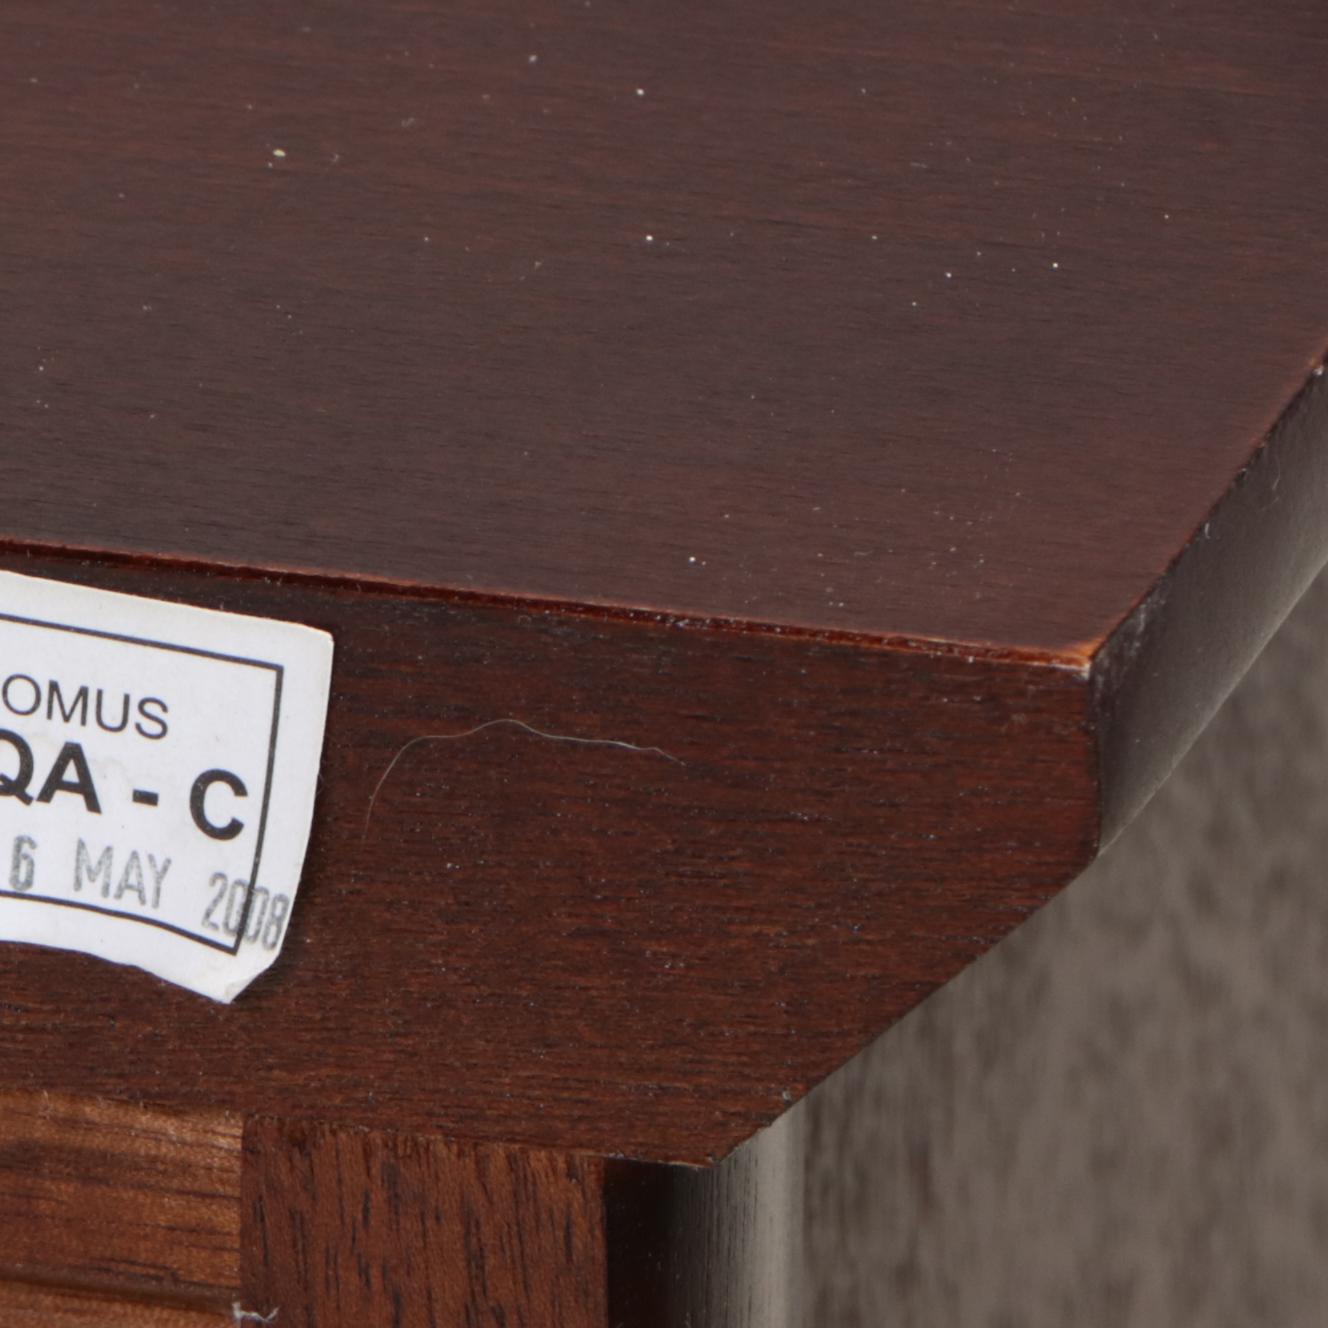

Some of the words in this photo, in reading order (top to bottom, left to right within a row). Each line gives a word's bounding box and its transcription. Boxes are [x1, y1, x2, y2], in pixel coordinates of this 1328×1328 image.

[188, 768, 248, 841] C
[72, 837, 173, 910] MAY
[200, 871, 291, 952] 2008
